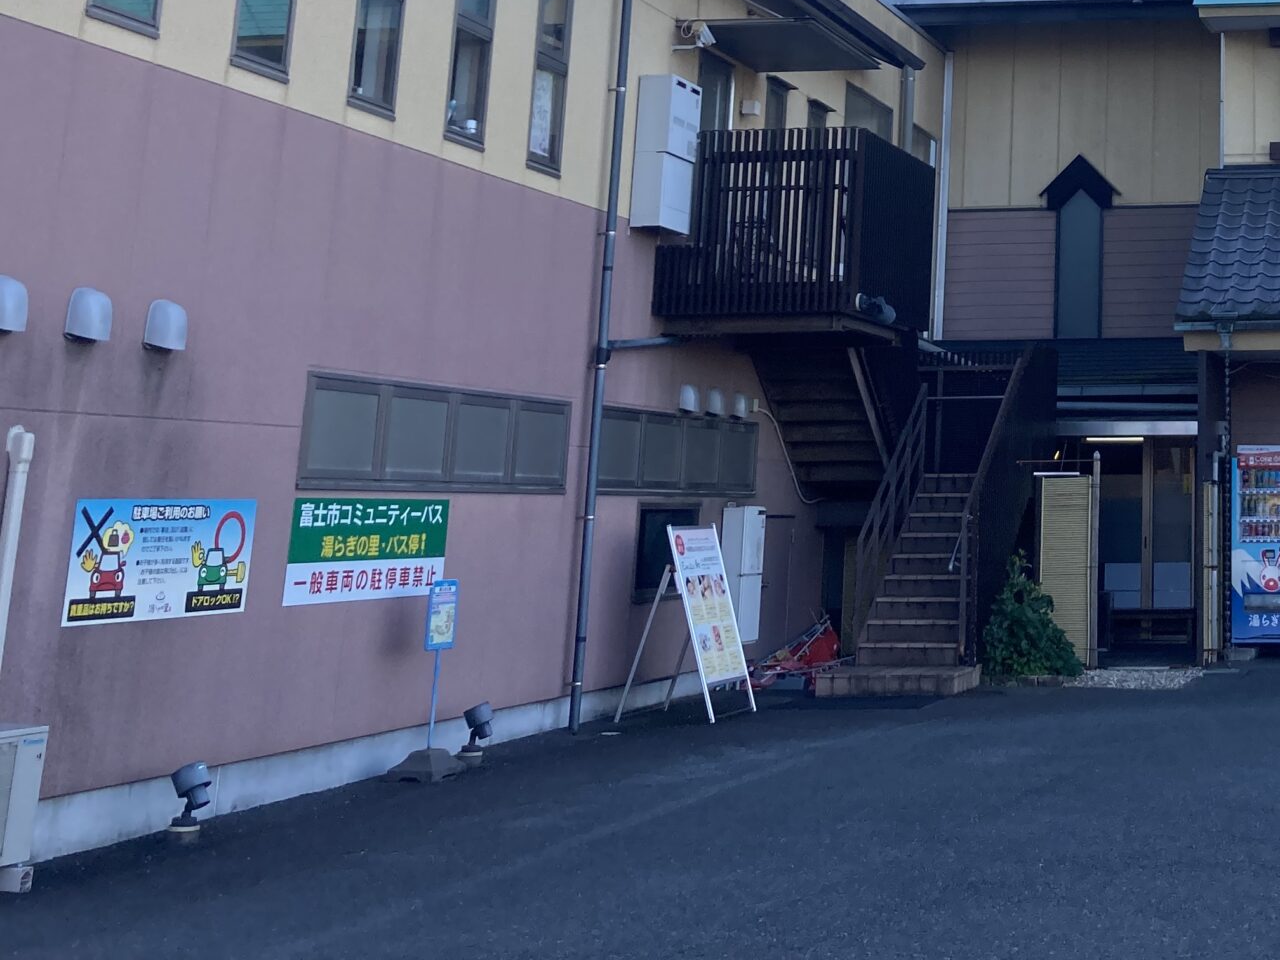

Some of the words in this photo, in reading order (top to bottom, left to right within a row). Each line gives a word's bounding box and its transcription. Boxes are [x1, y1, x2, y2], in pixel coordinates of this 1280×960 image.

[133, 505, 210, 521] 駐車場ご利用のお願い
[299, 502, 443, 528] 富士市コミュニティーバス
[320, 534, 422, 558] 湯らぎの里・バス停
[293, 565, 436, 595] 一般車両の駐停車禁止
